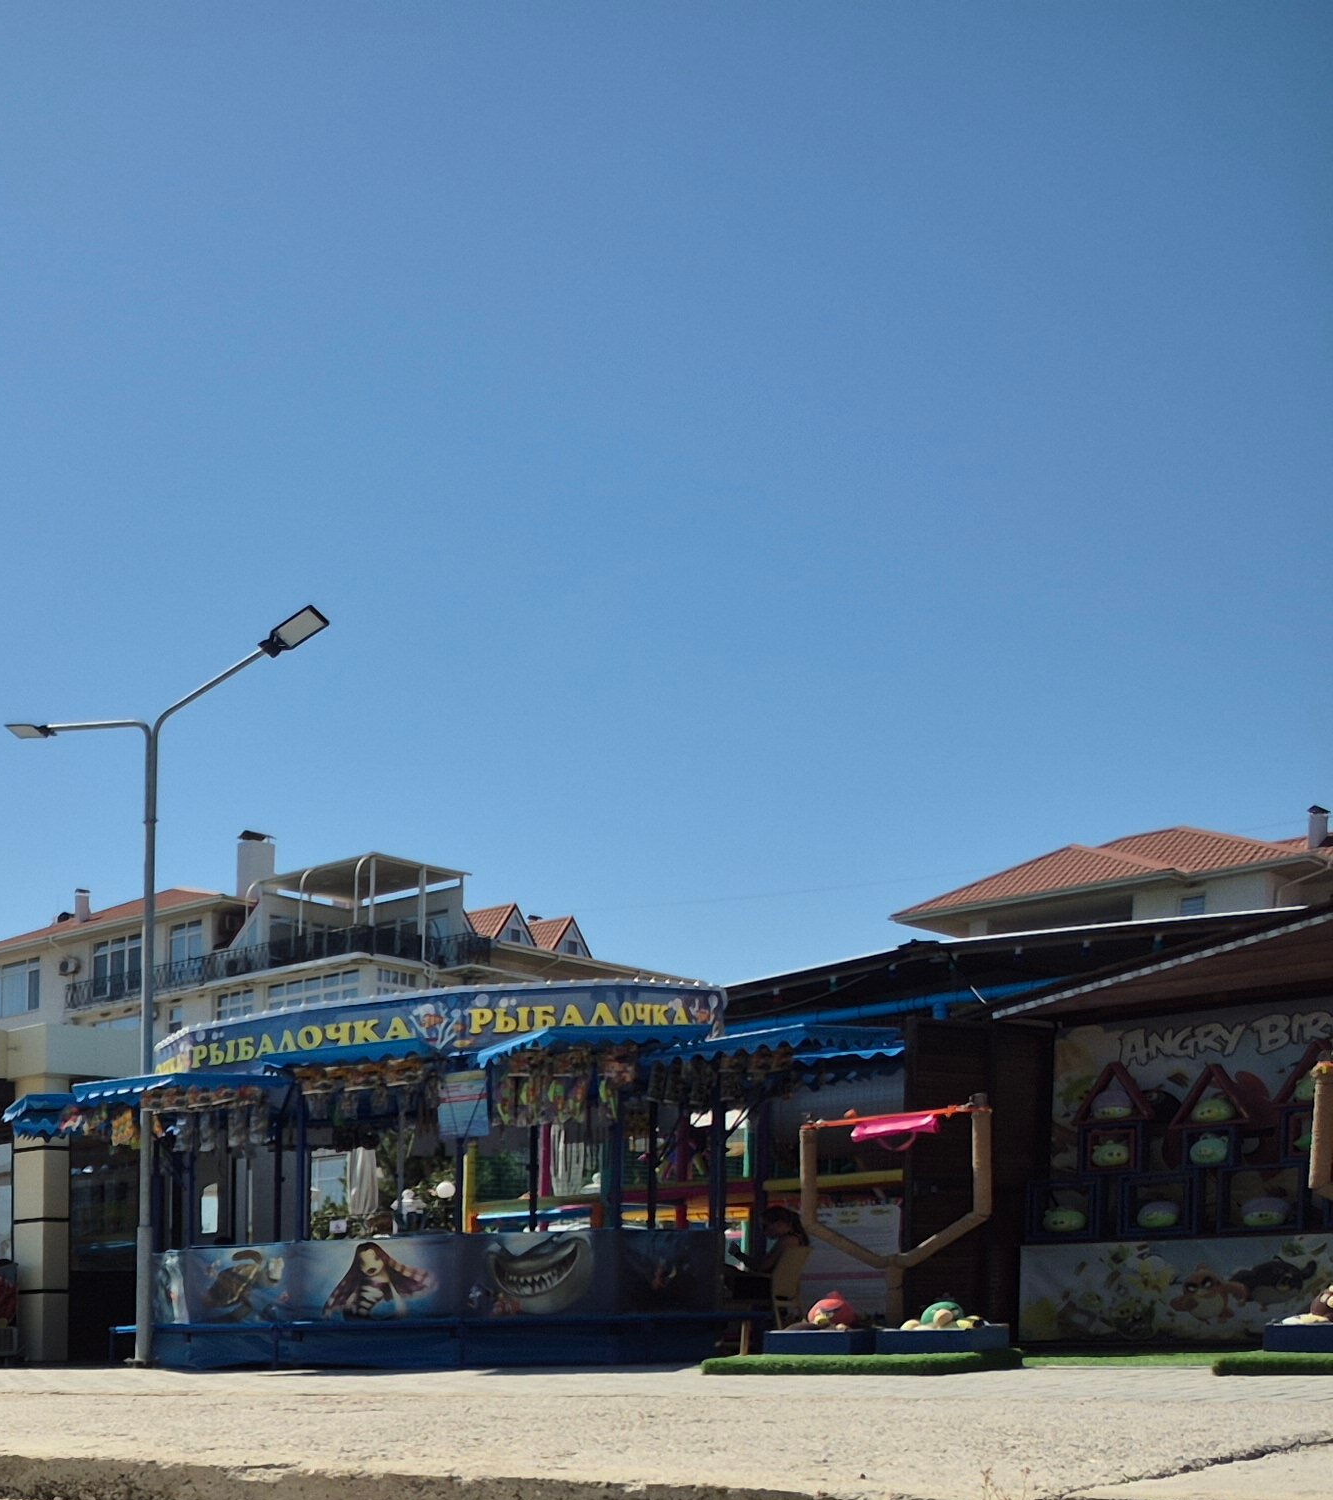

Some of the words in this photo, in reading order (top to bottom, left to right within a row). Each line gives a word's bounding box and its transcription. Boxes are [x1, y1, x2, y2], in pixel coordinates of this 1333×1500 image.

[468, 1001, 692, 1035] РЫБАЛОЧКА
[191, 1015, 413, 1069] РЫБАЛОЧКА
[1118, 1021, 1247, 1067] ANGRY
